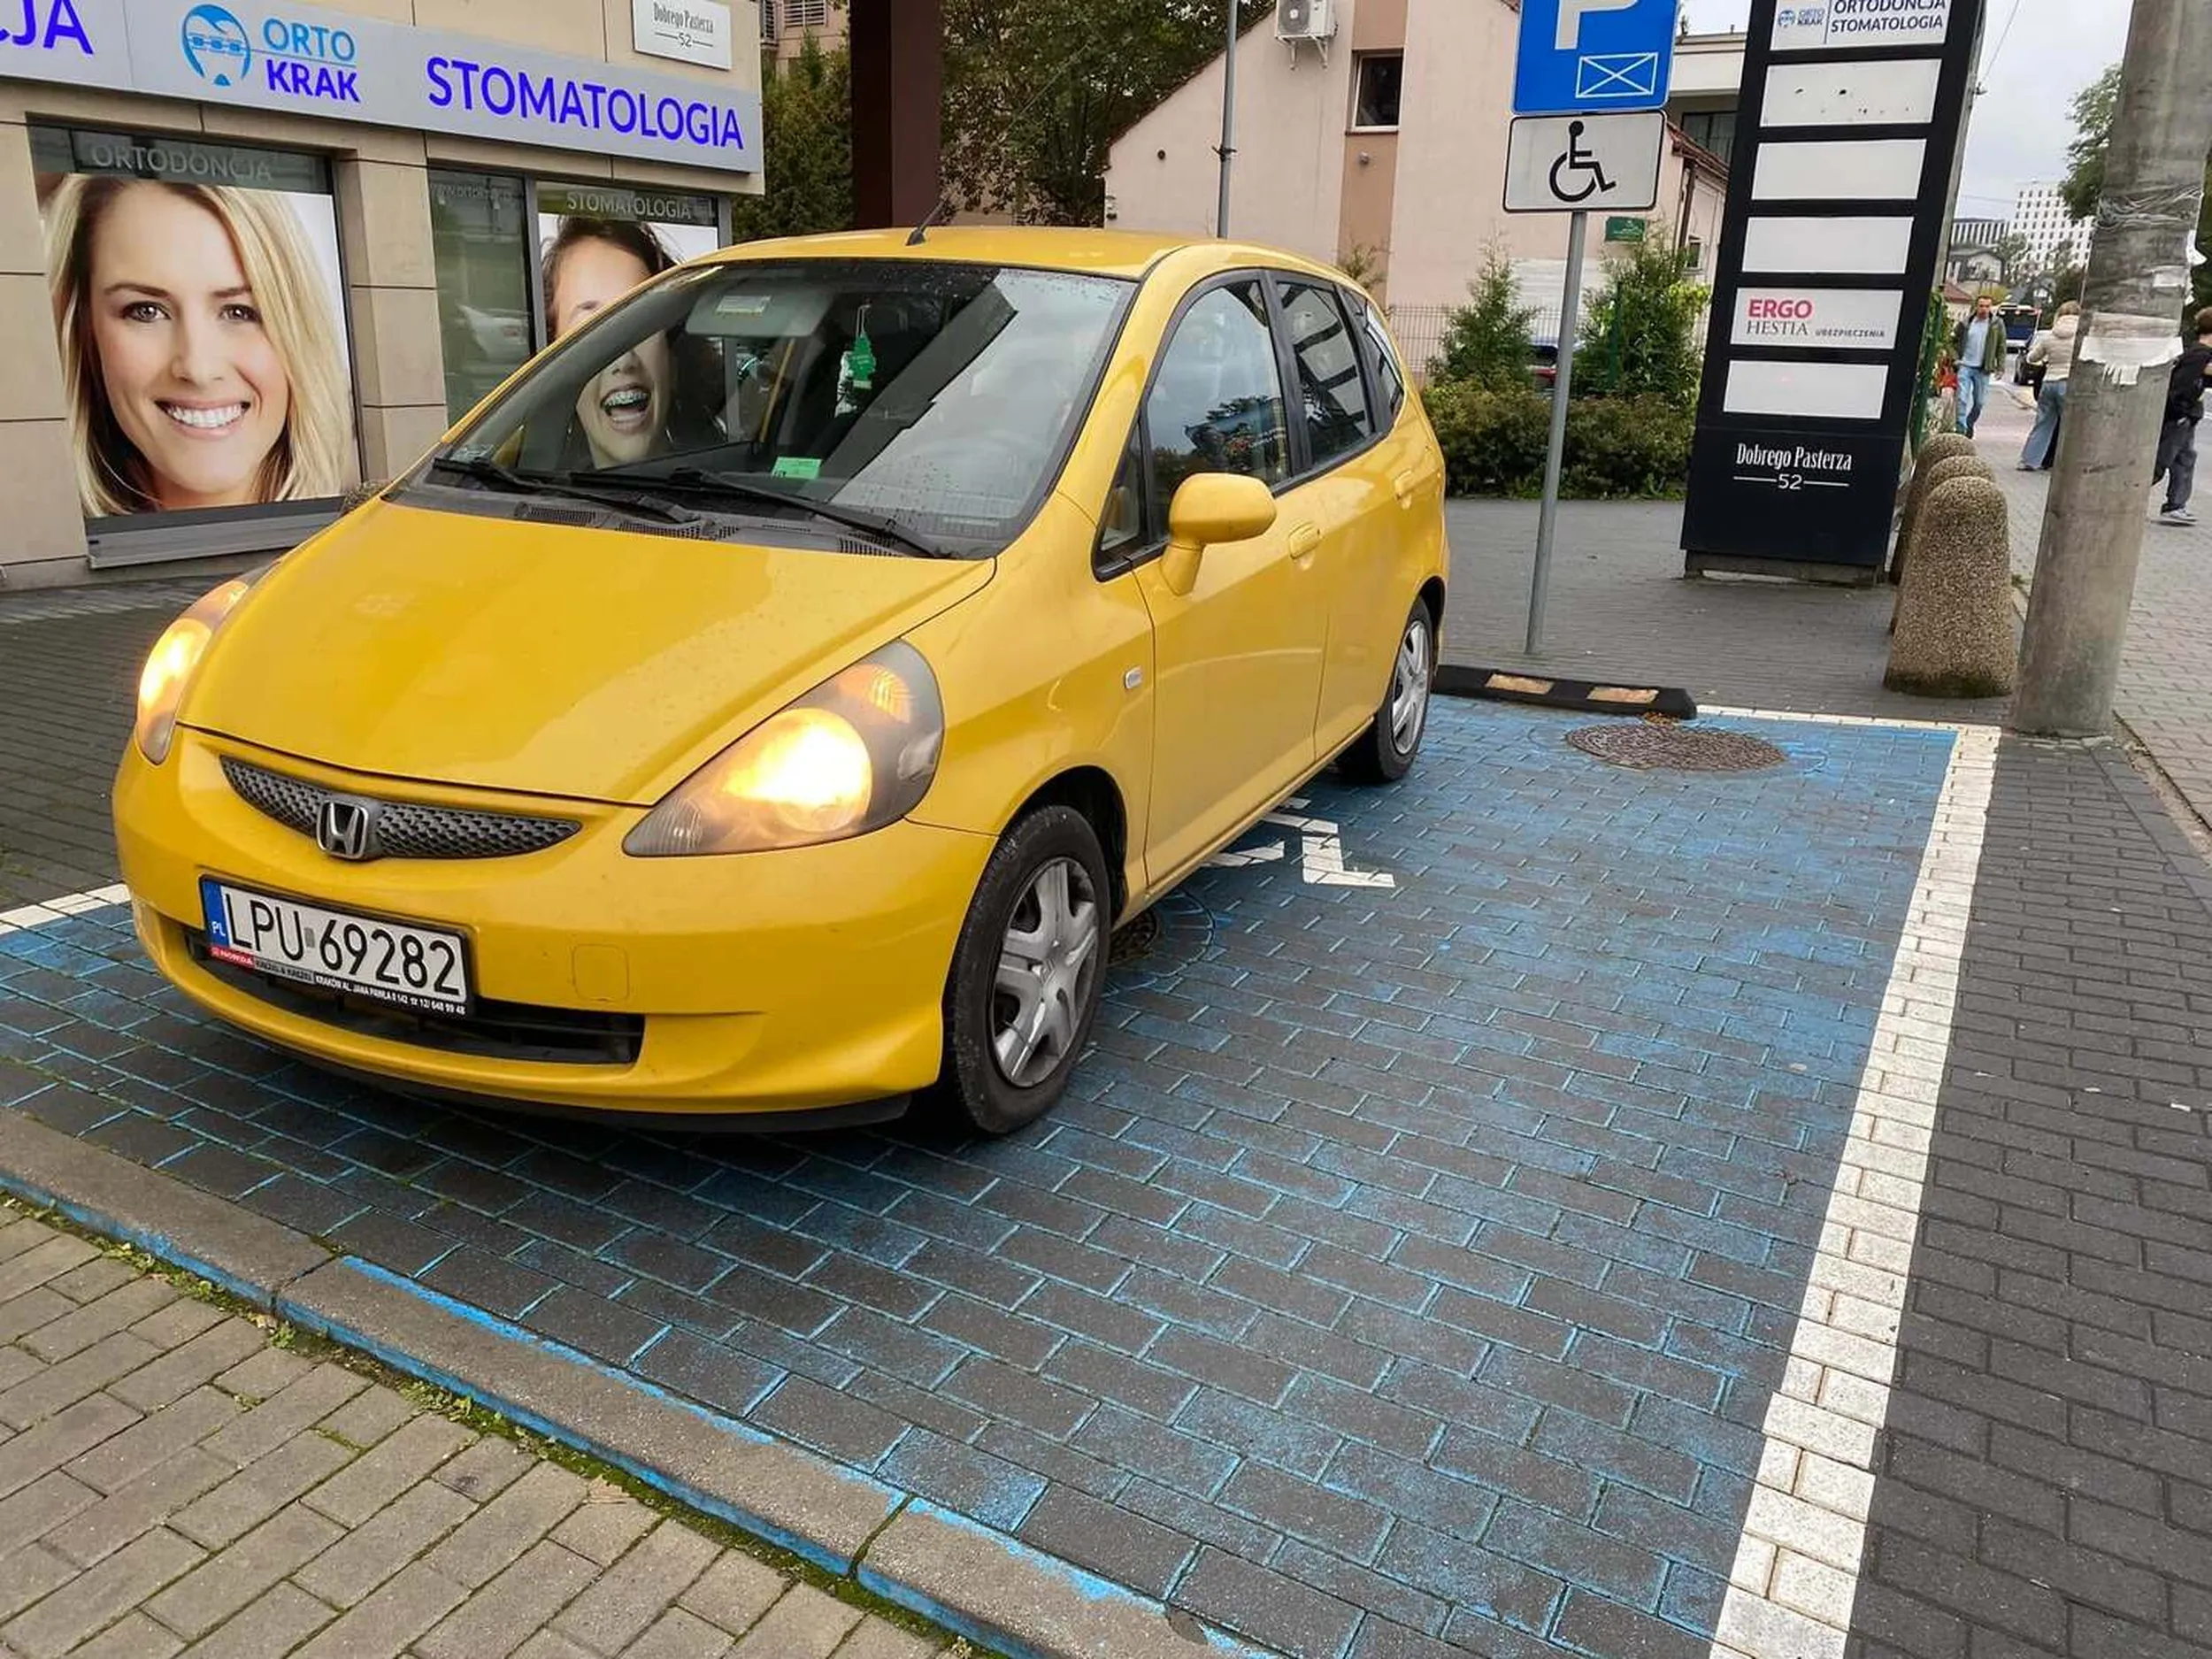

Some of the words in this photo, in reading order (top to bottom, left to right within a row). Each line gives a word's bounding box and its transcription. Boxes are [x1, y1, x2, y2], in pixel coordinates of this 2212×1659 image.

[0, 0, 95, 55] JA
[1831, 15, 1944, 33] STOMATOLOGIA
[263, 18, 356, 62] ORTO
[679, 32, 692, 47] 52
[265, 58, 361, 103] KRAK
[426, 57, 744, 150] STOMATOLOGIA
[91, 145, 272, 181] ORTODONCJA
[567, 191, 692, 220] STOMATOLOGIA
[1748, 298, 1813, 319] ERGO
[1747, 320, 1809, 335] HESTIA
[1736, 442, 1792, 470] Dobrego
[1793, 446, 1853, 471] Pasterza
[1778, 473, 1802, 490] 52
[211, 920, 226, 937] PL
[225, 893, 304, 961] LPU
[319, 919, 460, 995] 69282
